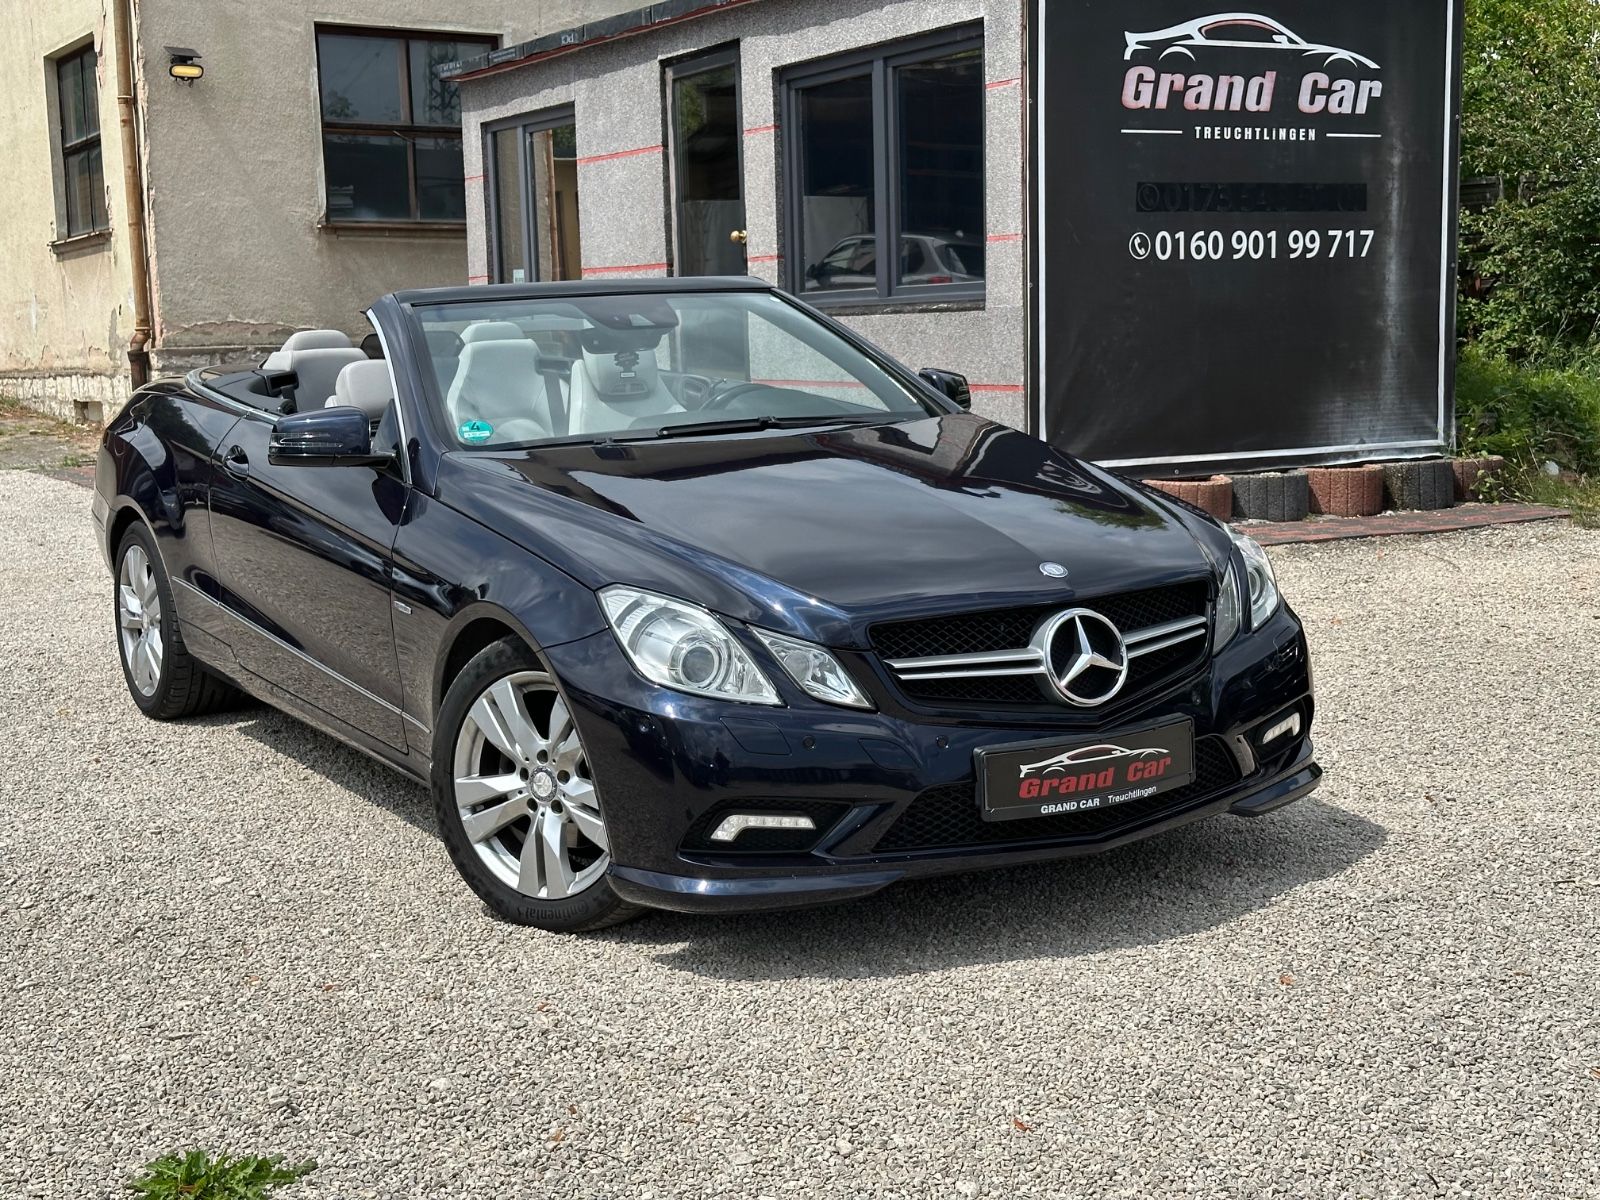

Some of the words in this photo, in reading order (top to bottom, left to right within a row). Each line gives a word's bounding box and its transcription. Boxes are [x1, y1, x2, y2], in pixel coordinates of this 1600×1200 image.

[1121, 66, 1277, 112] Grand
[1297, 72, 1383, 114] Car
[1194, 126, 1317, 141] TREUCHTLINGEN
[1154, 230, 1224, 261] 0160
[1231, 230, 1277, 260] 901
[1287, 230, 1320, 259] 99
[1327, 229, 1375, 258] 717
[1019, 767, 1114, 798] Grand
[1127, 756, 1171, 781] Car
[1040, 802, 1078, 814] GRAND
[1079, 798, 1100, 809] CAR
[1107, 785, 1157, 804] Treuchtlingen
